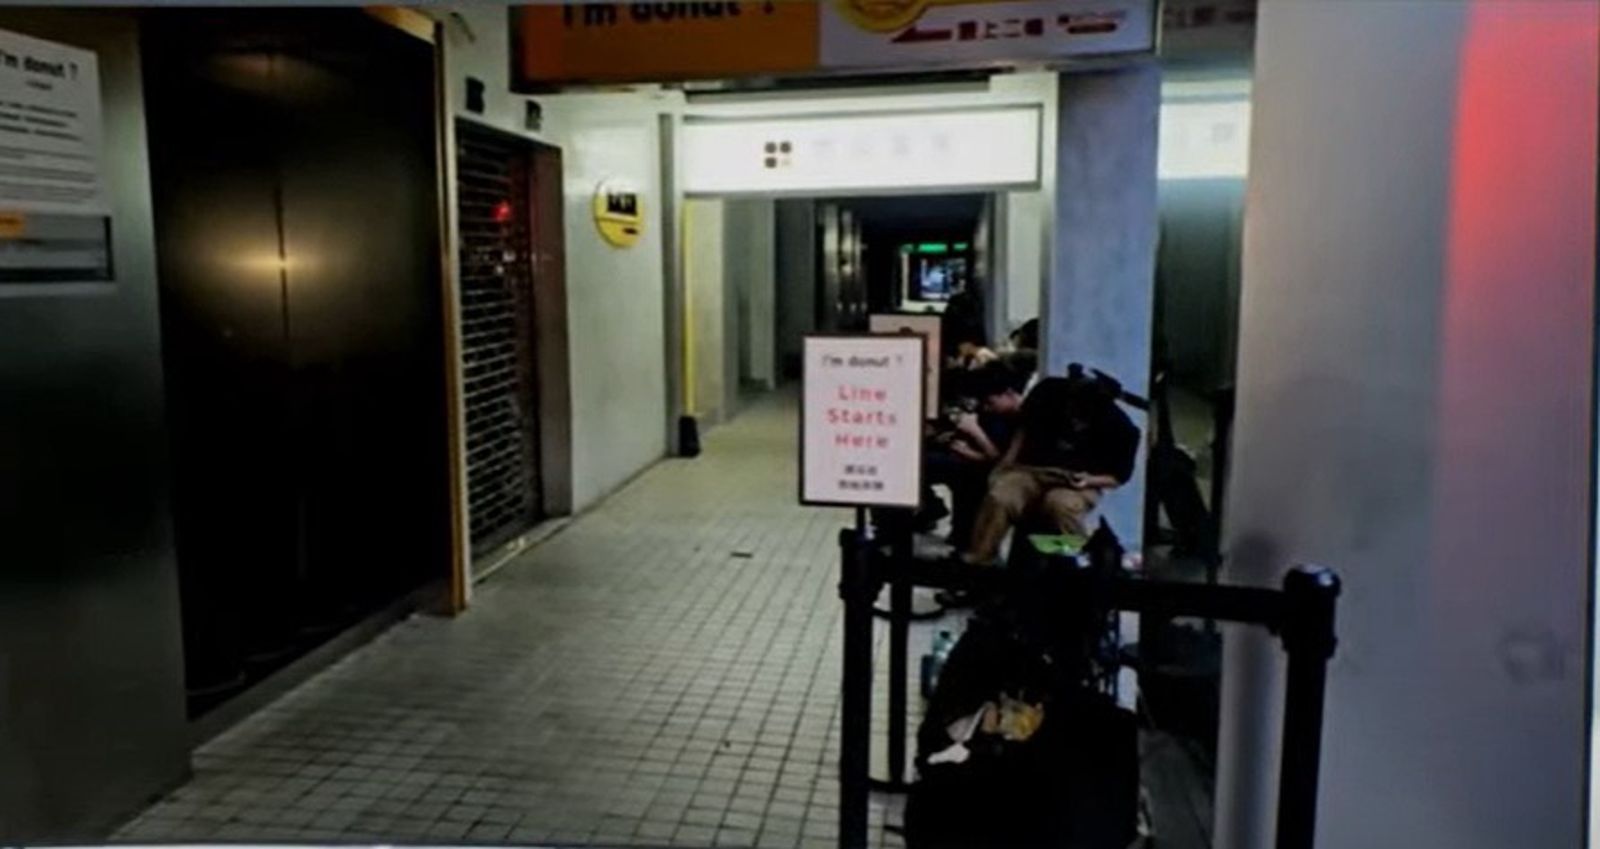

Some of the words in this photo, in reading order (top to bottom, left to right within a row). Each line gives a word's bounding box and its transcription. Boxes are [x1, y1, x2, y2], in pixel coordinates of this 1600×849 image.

[564, 1, 617, 27] Im
[822, 354, 843, 367] I'm
[848, 354, 890, 368] donut
[838, 384, 887, 402] Line
[826, 408, 897, 425] Starts
[834, 434, 889, 448] Here
